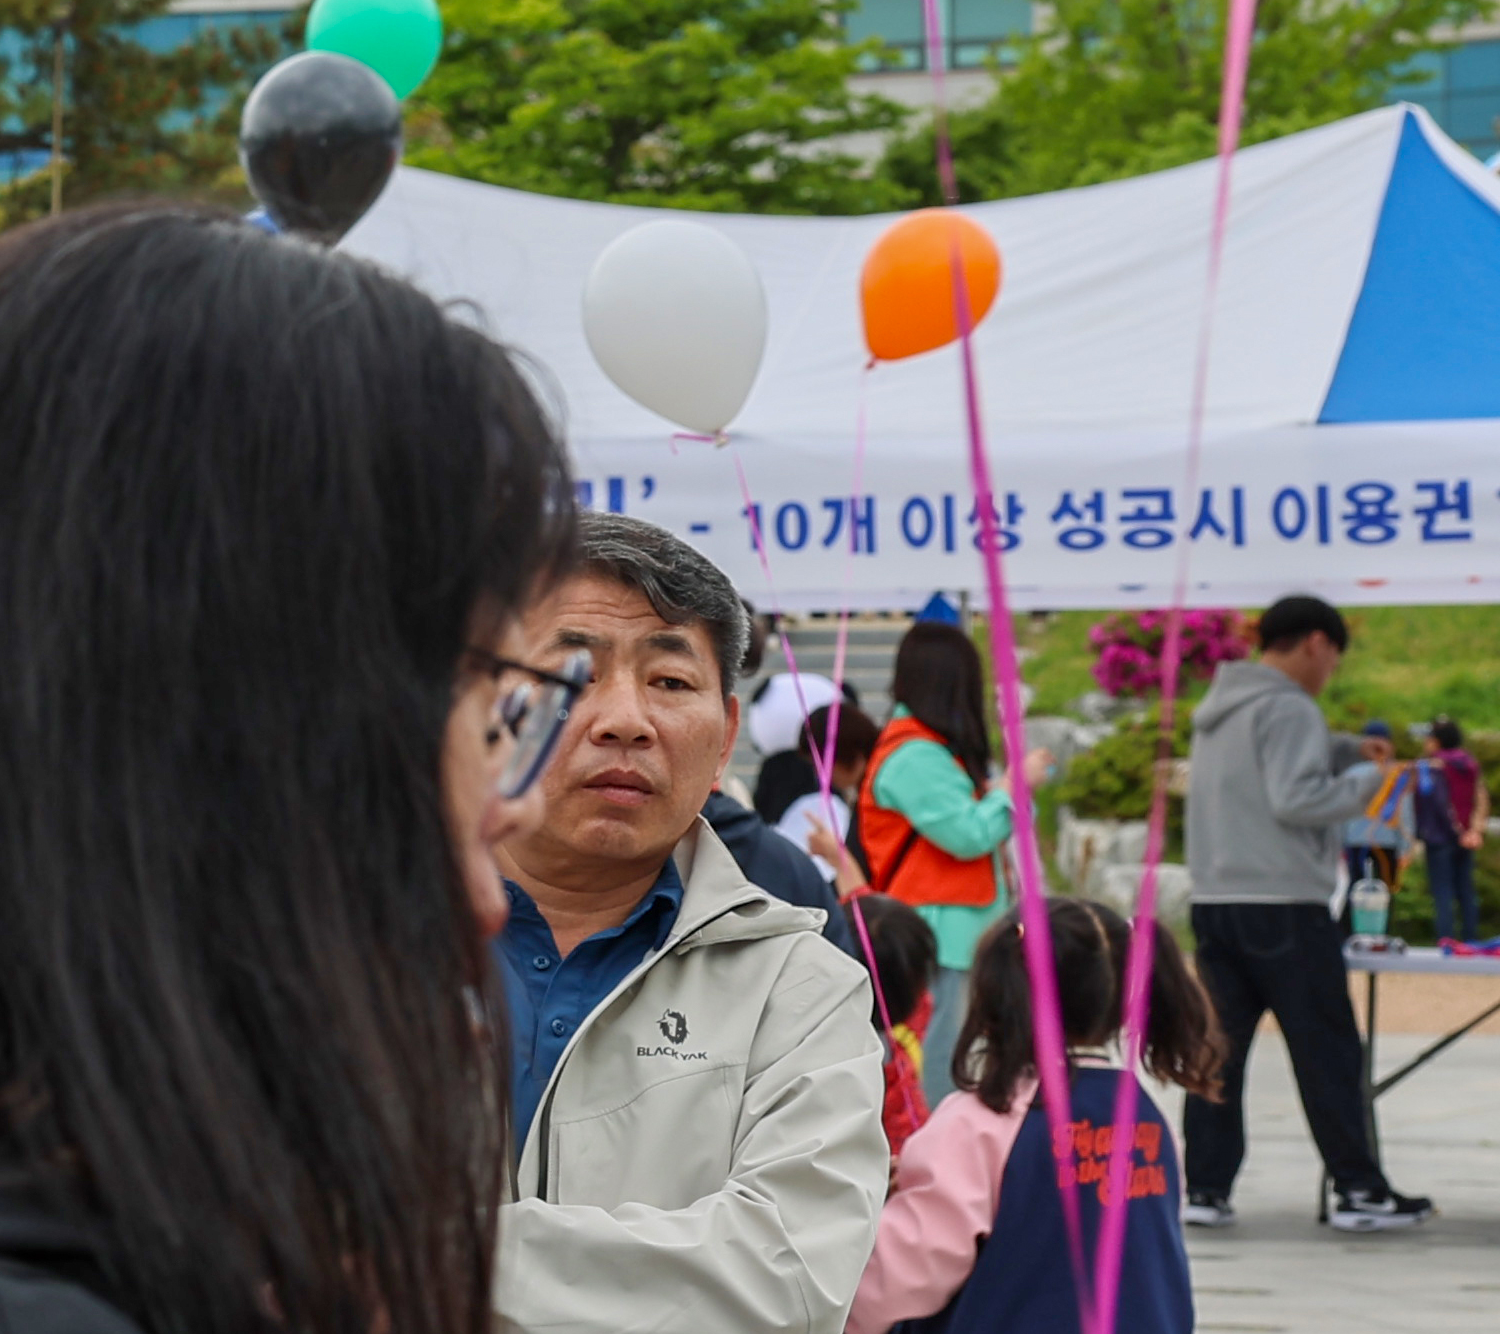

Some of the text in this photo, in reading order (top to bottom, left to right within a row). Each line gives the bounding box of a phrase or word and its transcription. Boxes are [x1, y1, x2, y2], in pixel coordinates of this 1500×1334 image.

[741, 495, 878, 555] 10개
[900, 493, 1025, 553] 이상
[1050, 487, 1247, 552] 성공시
[1271, 479, 1475, 546] 이용권
